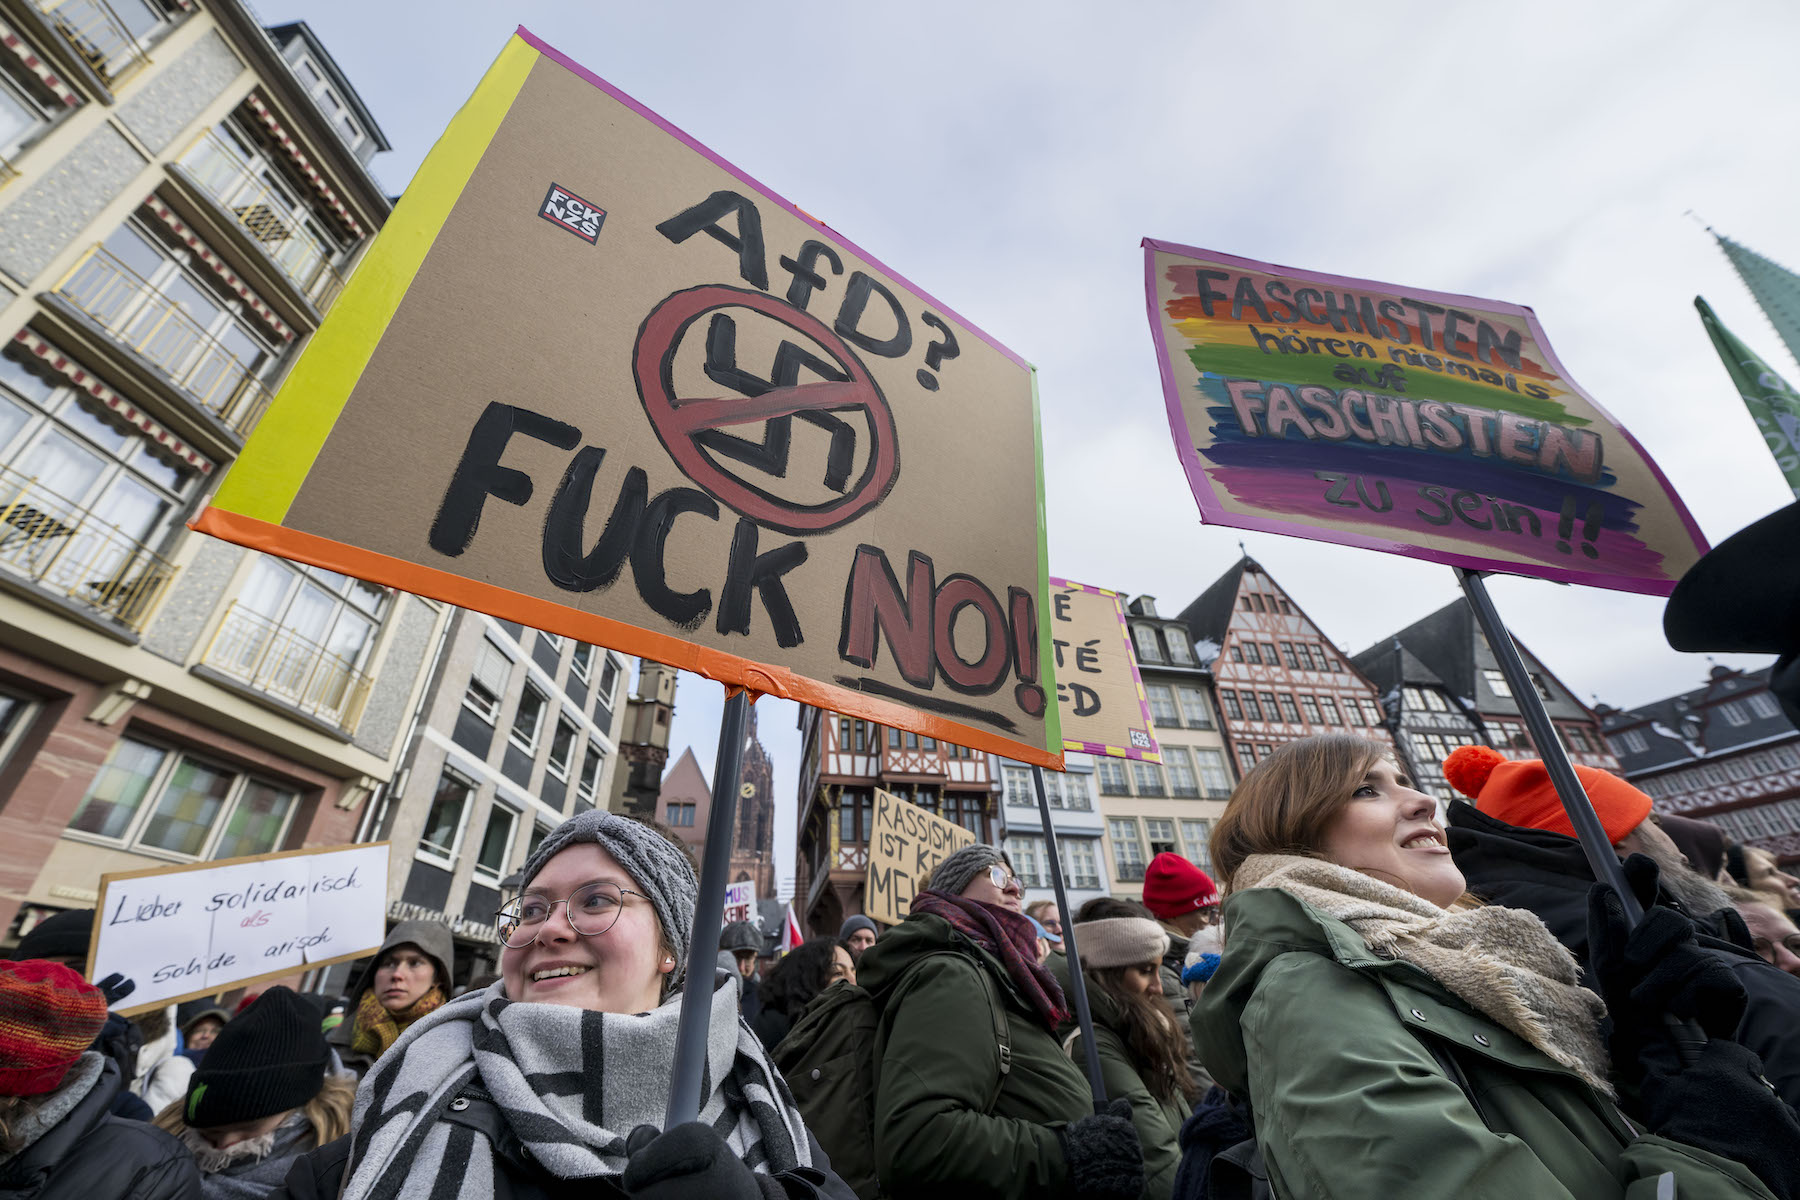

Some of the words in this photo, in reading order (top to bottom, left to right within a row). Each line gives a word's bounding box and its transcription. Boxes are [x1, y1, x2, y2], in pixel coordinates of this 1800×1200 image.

[545, 200, 597, 237] NZS
[549, 189, 602, 227] FCK
[655, 190, 961, 393] AfD?
[1195, 268, 1523, 372] FASCHISTEN
[1247, 323, 1378, 358] hören
[1386, 344, 1552, 401] niemals
[1331, 362, 1409, 393] auf
[1222, 376, 1605, 483] FASCHISTEN
[428, 400, 809, 649] FUCK
[837, 543, 1049, 721] NO!
[1129, 729, 1149, 742] FCK
[1132, 738, 1151, 749] NZS
[879, 832, 910, 862] IST
[109, 894, 183, 927] Lieber
[240, 909, 273, 929] als
[264, 926, 333, 958] arisch
